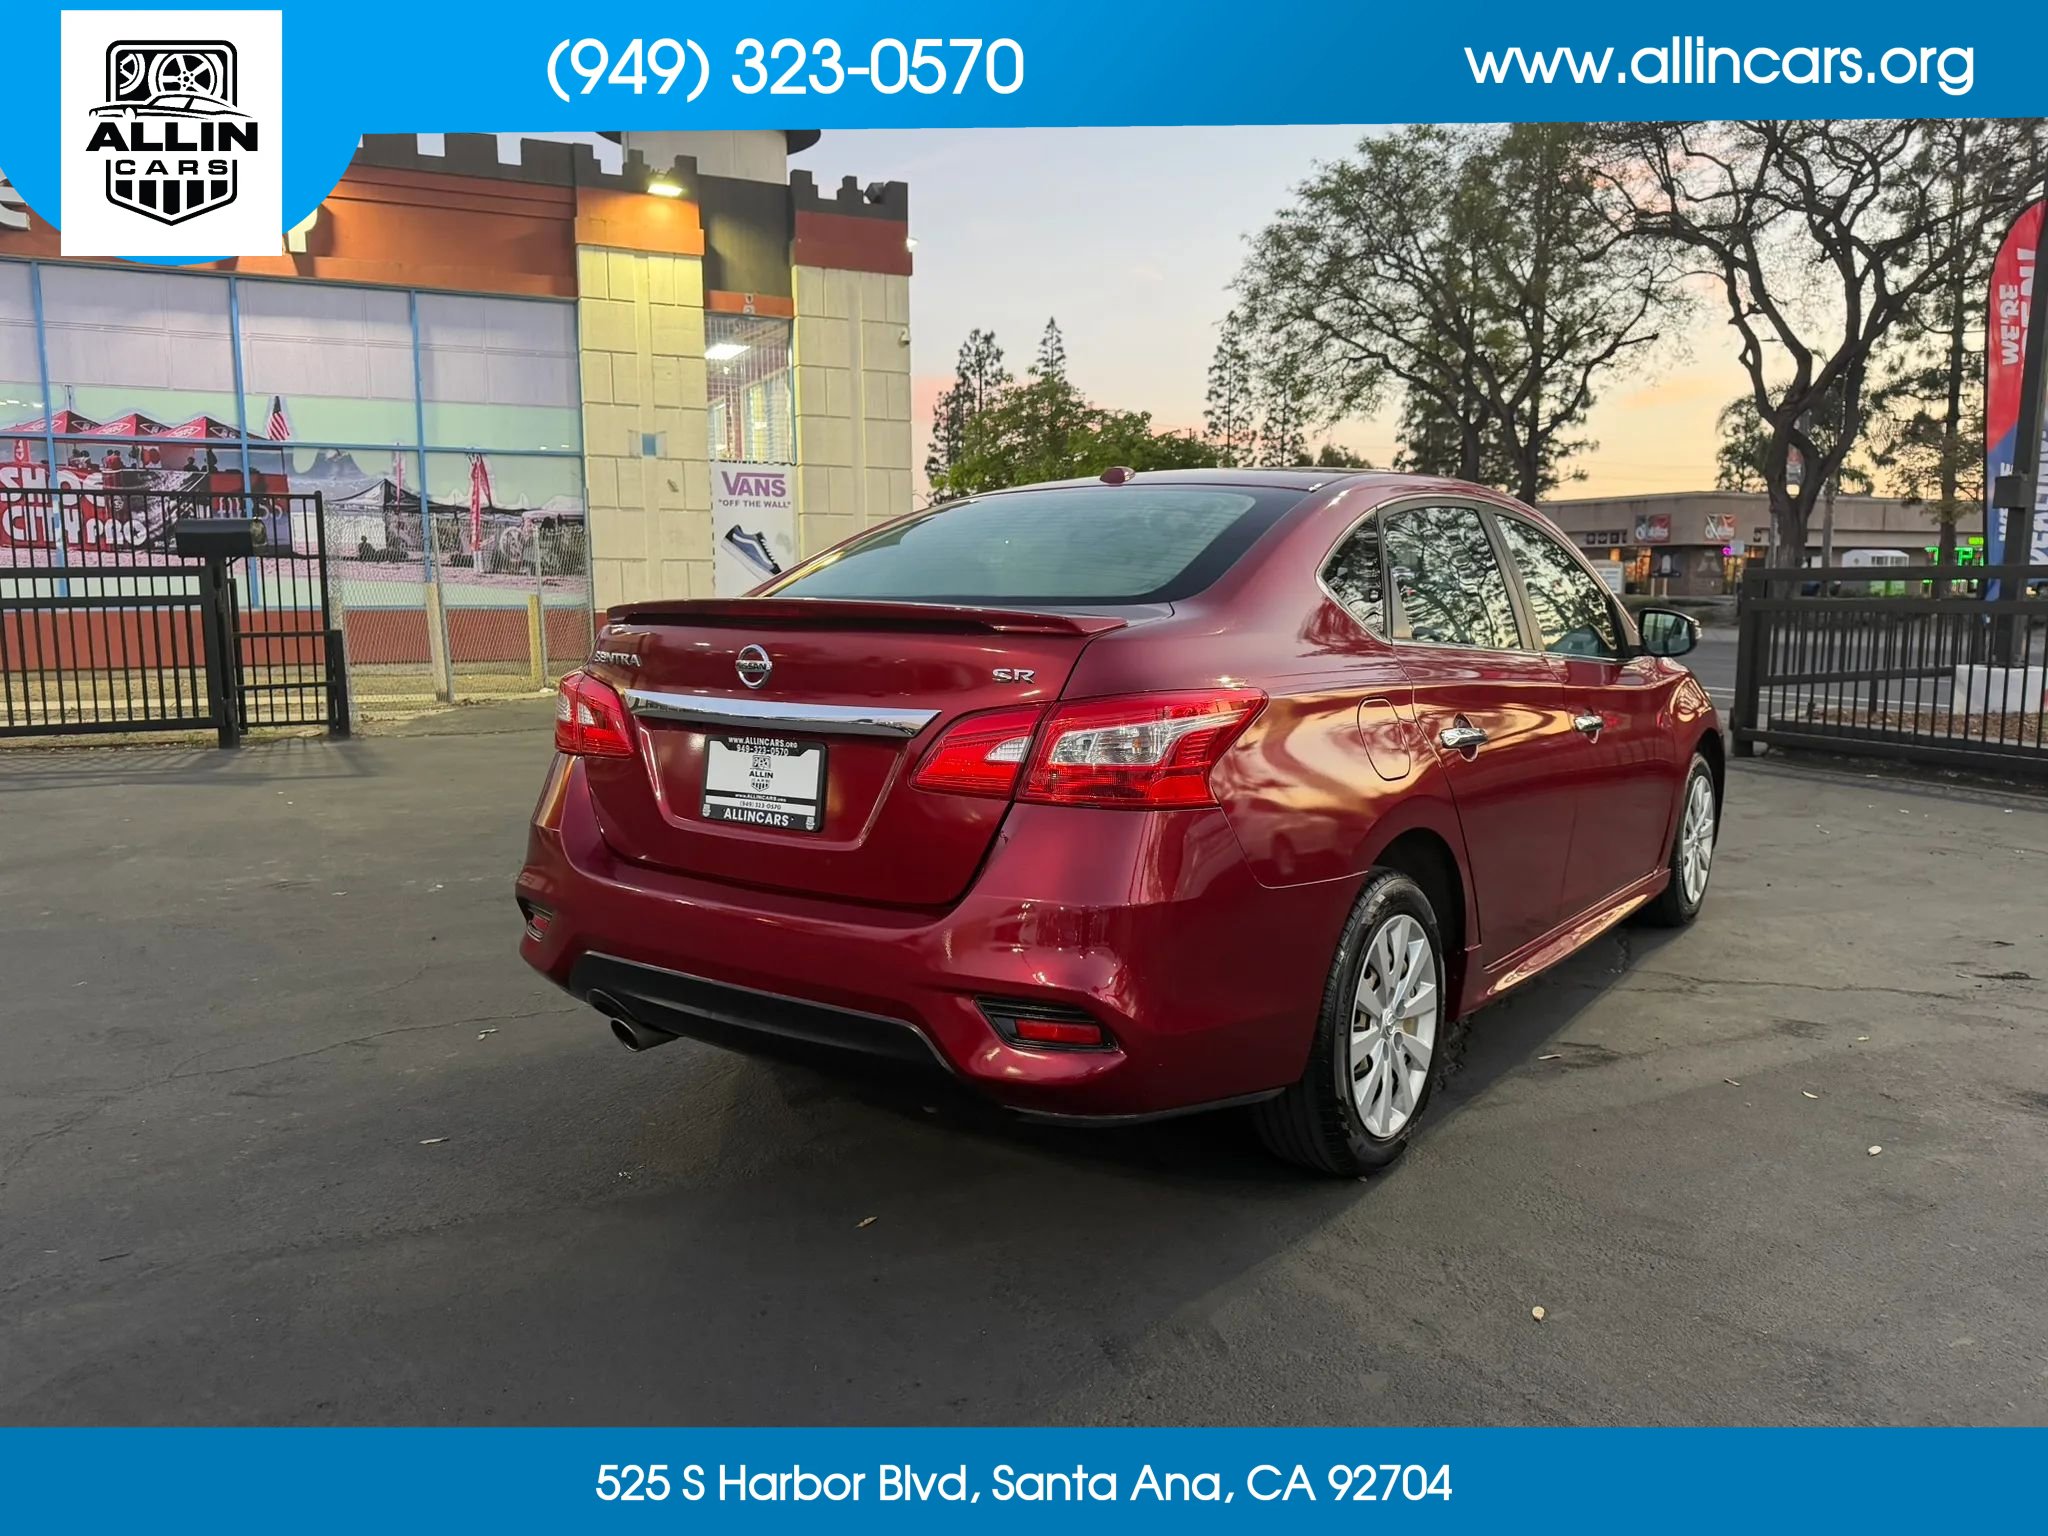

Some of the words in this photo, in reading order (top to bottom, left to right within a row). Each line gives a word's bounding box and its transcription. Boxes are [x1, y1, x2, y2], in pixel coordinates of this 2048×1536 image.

[1999, 284, 2020, 366] WE'RE
[721, 471, 787, 497] VANS
[743, 500, 761, 508] THE
[2, 505, 81, 545] CITY
[86, 517, 148, 546] PRO
[594, 650, 641, 668] SENTRA
[992, 668, 1035, 684] SR
[736, 744, 789, 757] 949-323-0570
[749, 770, 774, 779] ALLIN
[723, 808, 789, 826] ALLINCARS
